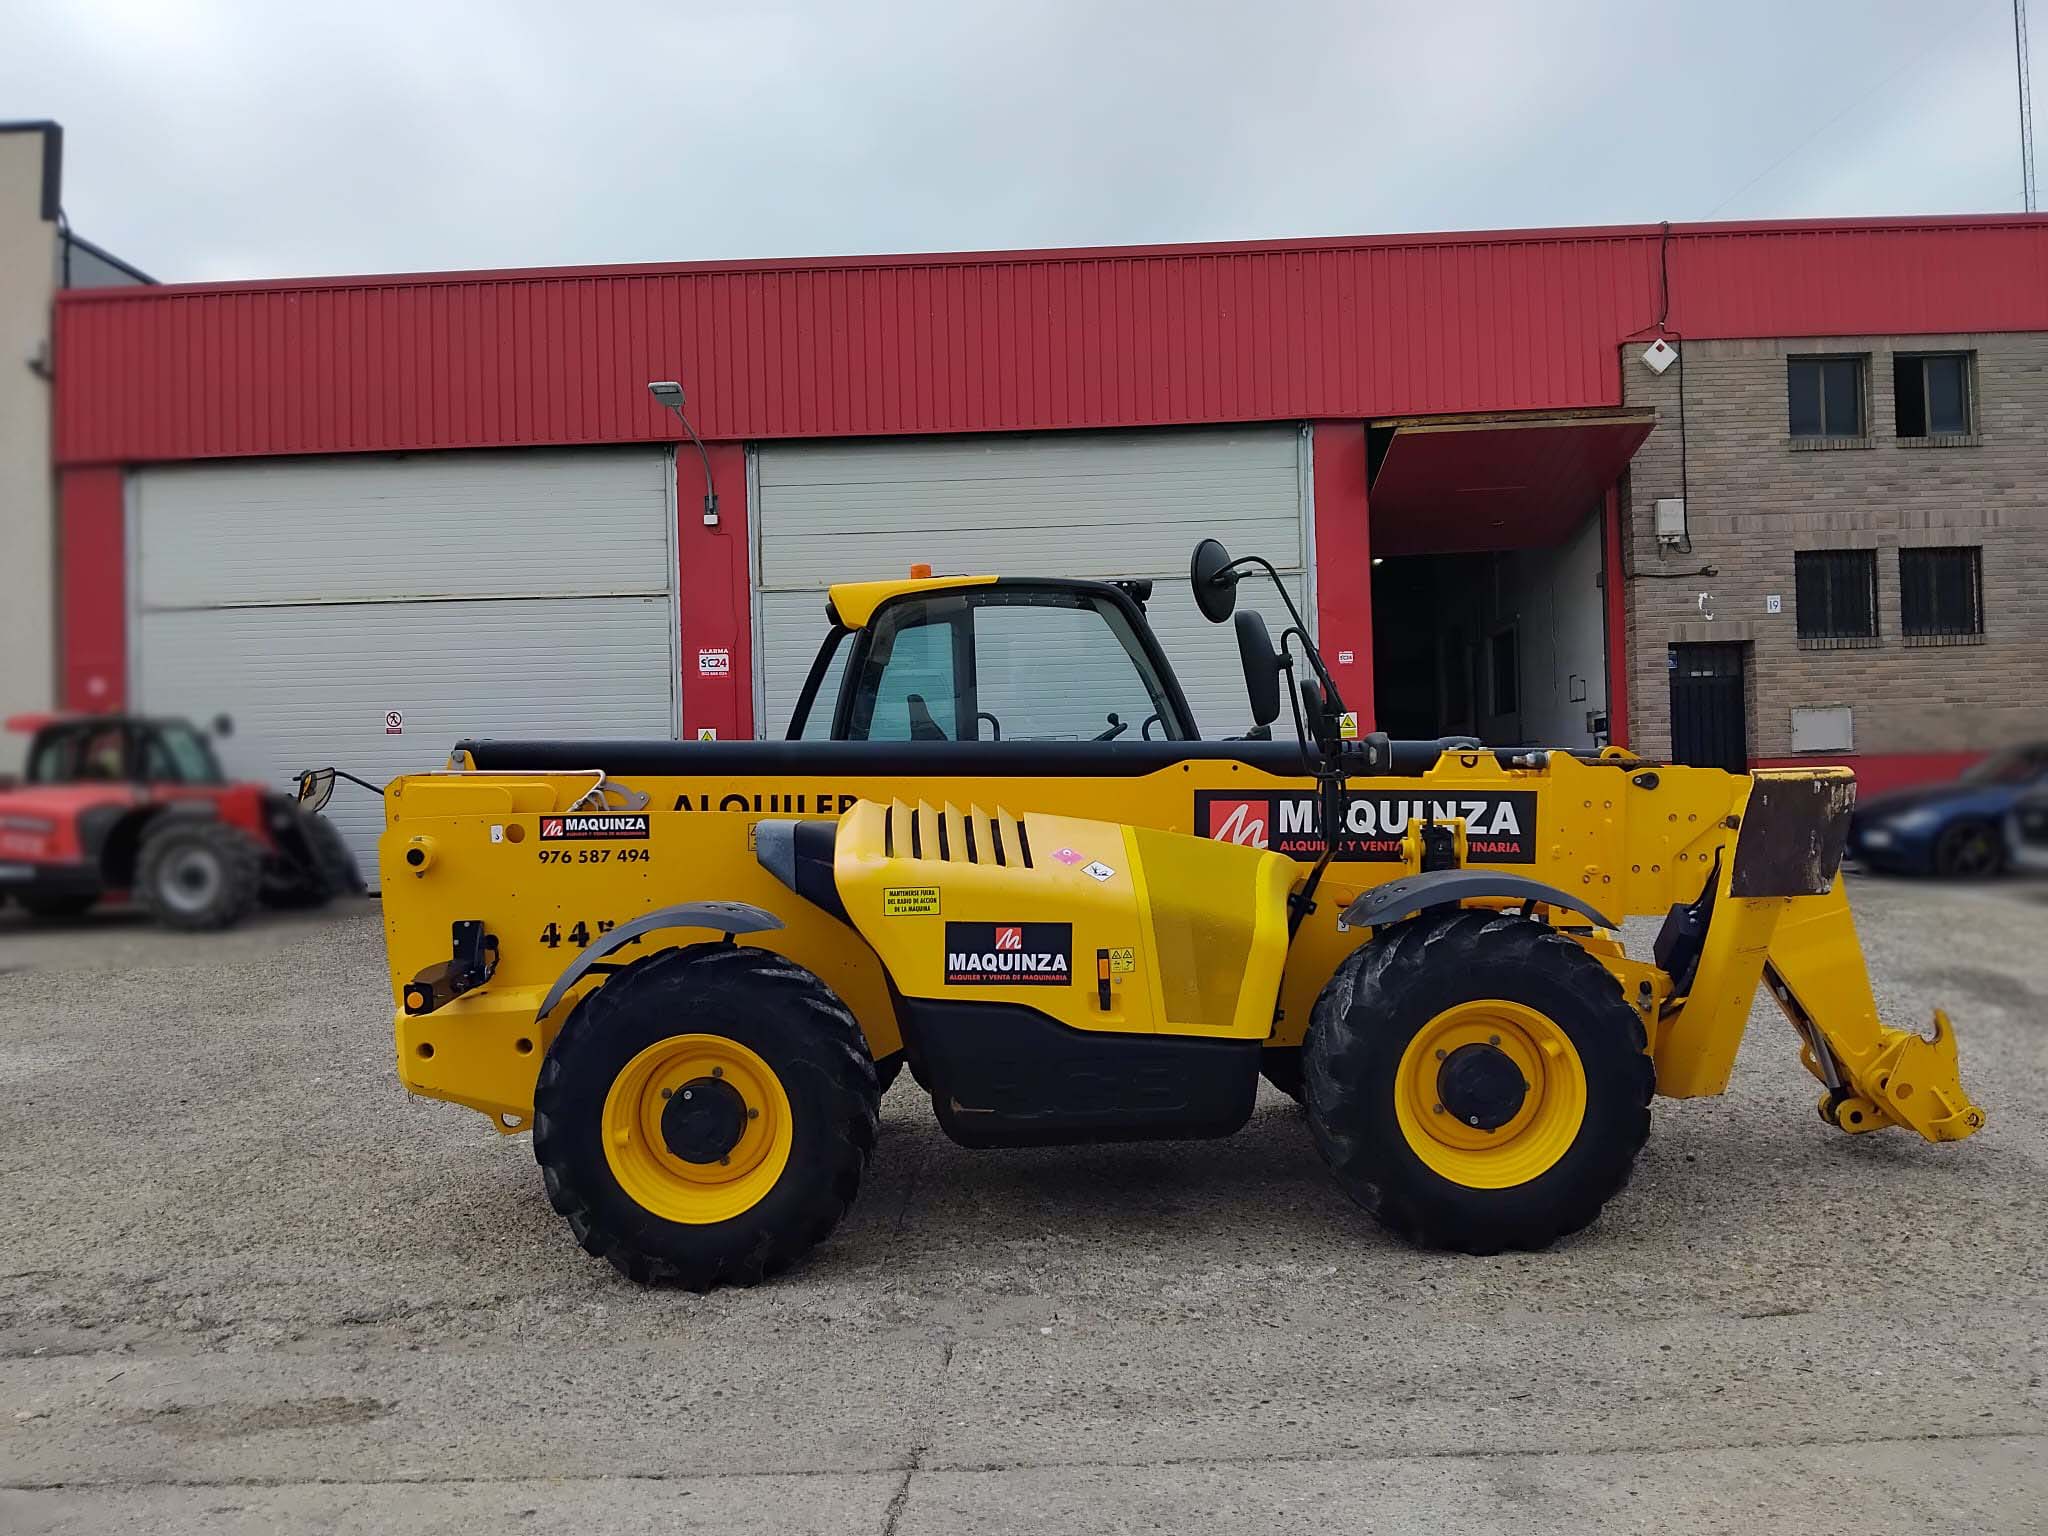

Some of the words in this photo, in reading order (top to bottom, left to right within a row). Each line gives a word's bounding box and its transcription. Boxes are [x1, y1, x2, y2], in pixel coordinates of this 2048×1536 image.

[1769, 600, 1779, 610] 19
[565, 817, 646, 831] MAQUINZA
[1279, 799, 1521, 837] MQUINZA
[1347, 840, 1356, 851] Y
[538, 850, 572, 864] 976
[578, 849, 611, 864] 587
[616, 848, 650, 863] 494
[948, 953, 1068, 972] MAQUINZA
